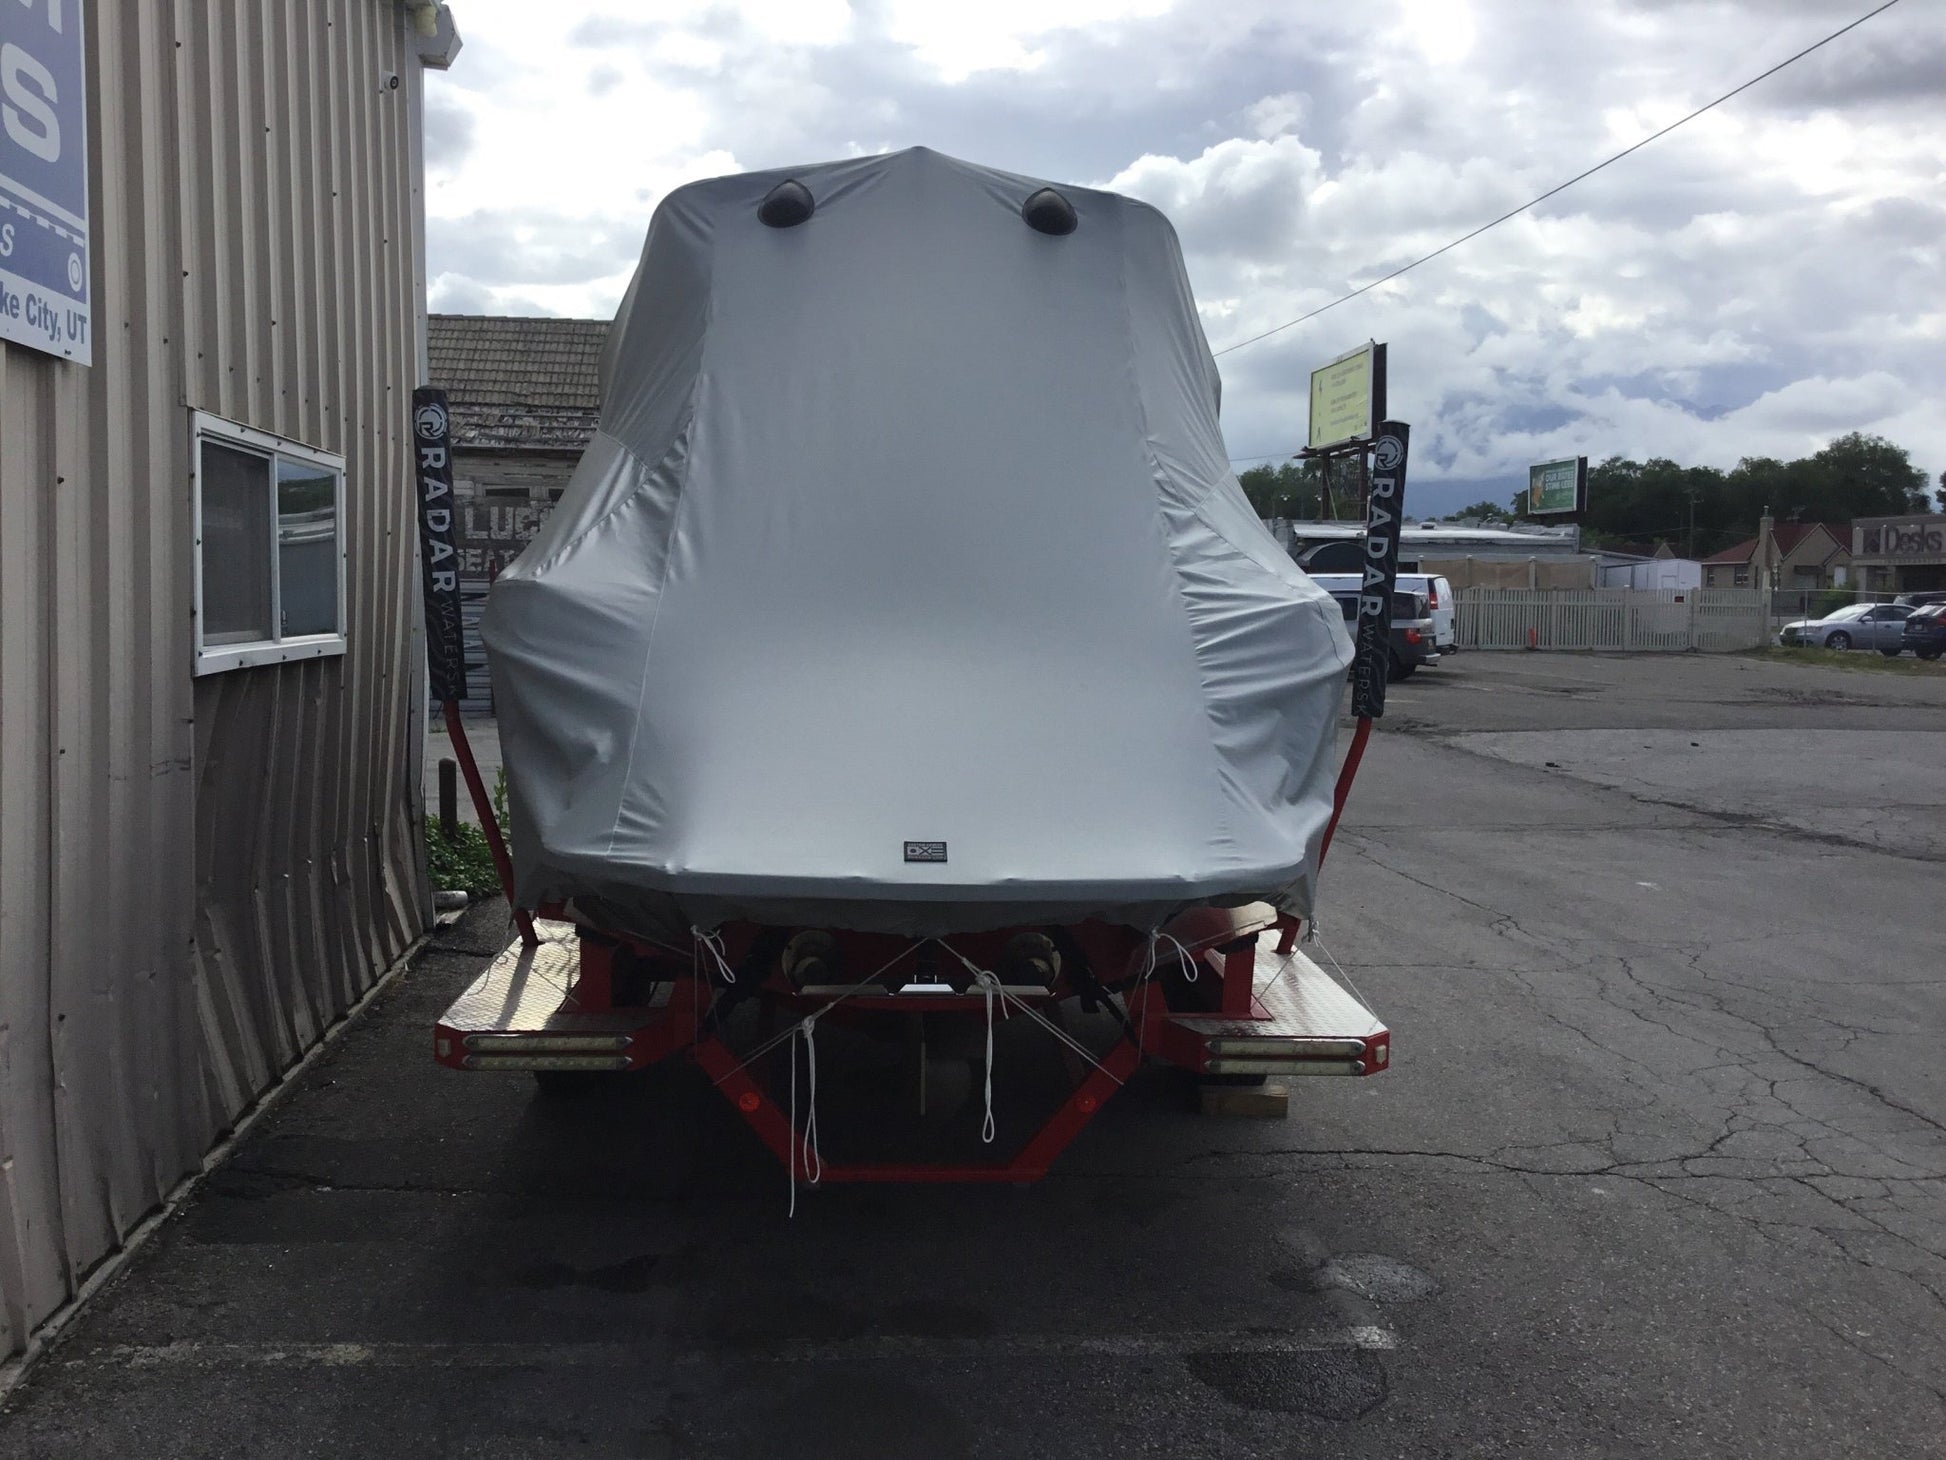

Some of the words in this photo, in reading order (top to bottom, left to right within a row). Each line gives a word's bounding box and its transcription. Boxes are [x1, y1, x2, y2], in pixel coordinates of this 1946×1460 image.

[26, 293, 61, 342] City,
[66, 308, 88, 344] UT
[420, 447, 457, 592] RADAR
[1359, 476, 1395, 617] RADAR
[1885, 524, 1942, 556] Desks
